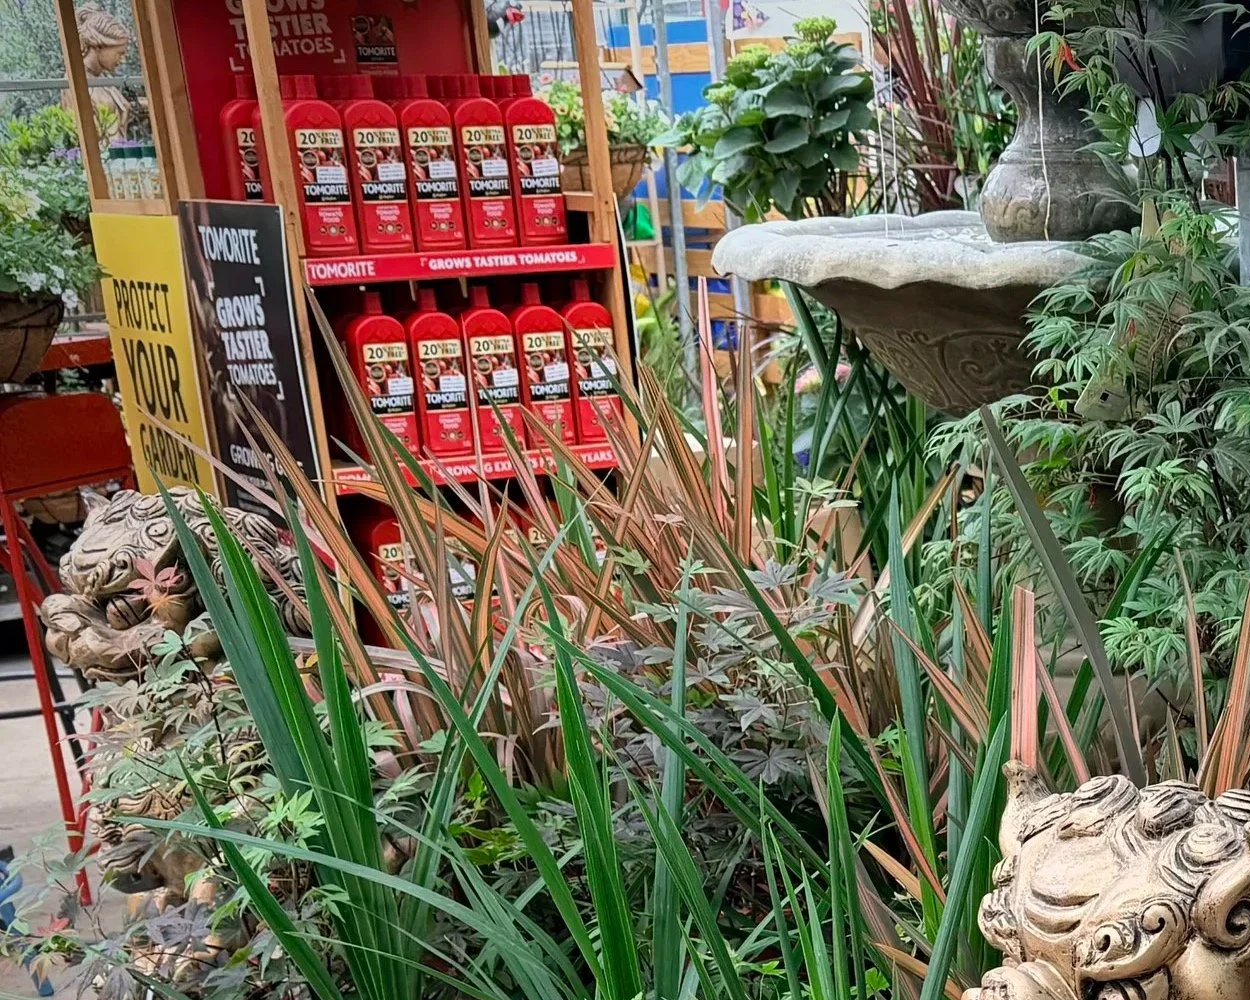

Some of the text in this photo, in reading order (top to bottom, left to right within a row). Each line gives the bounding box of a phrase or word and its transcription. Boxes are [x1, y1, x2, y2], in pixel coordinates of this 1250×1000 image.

[304, 185, 349, 196] TOMORITE
[362, 183, 405, 195] TOMORITE
[416, 181, 457, 193] TOMORITE
[469, 179, 509, 190] TOMORITE
[520, 177, 560, 189] TOMORITE
[198, 226, 261, 265] TOMORITE
[428, 251, 577, 270] GROWS TASTIER TOMATOES
[307, 260, 377, 280] TOMORITE
[113, 279, 172, 334] PROTECT
[215, 294, 266, 328] GROWS
[221, 330, 273, 360] TASTIER
[121, 338, 188, 423] YOUR
[226, 363, 276, 386] TOMATOES
[530, 383, 568, 395] TOMORITE
[371, 396, 412, 408] TOMORITE
[425, 392, 466, 404] TOMORITE
[139, 423, 199, 485] GARDEN
[580, 452, 613, 463] YEARS
